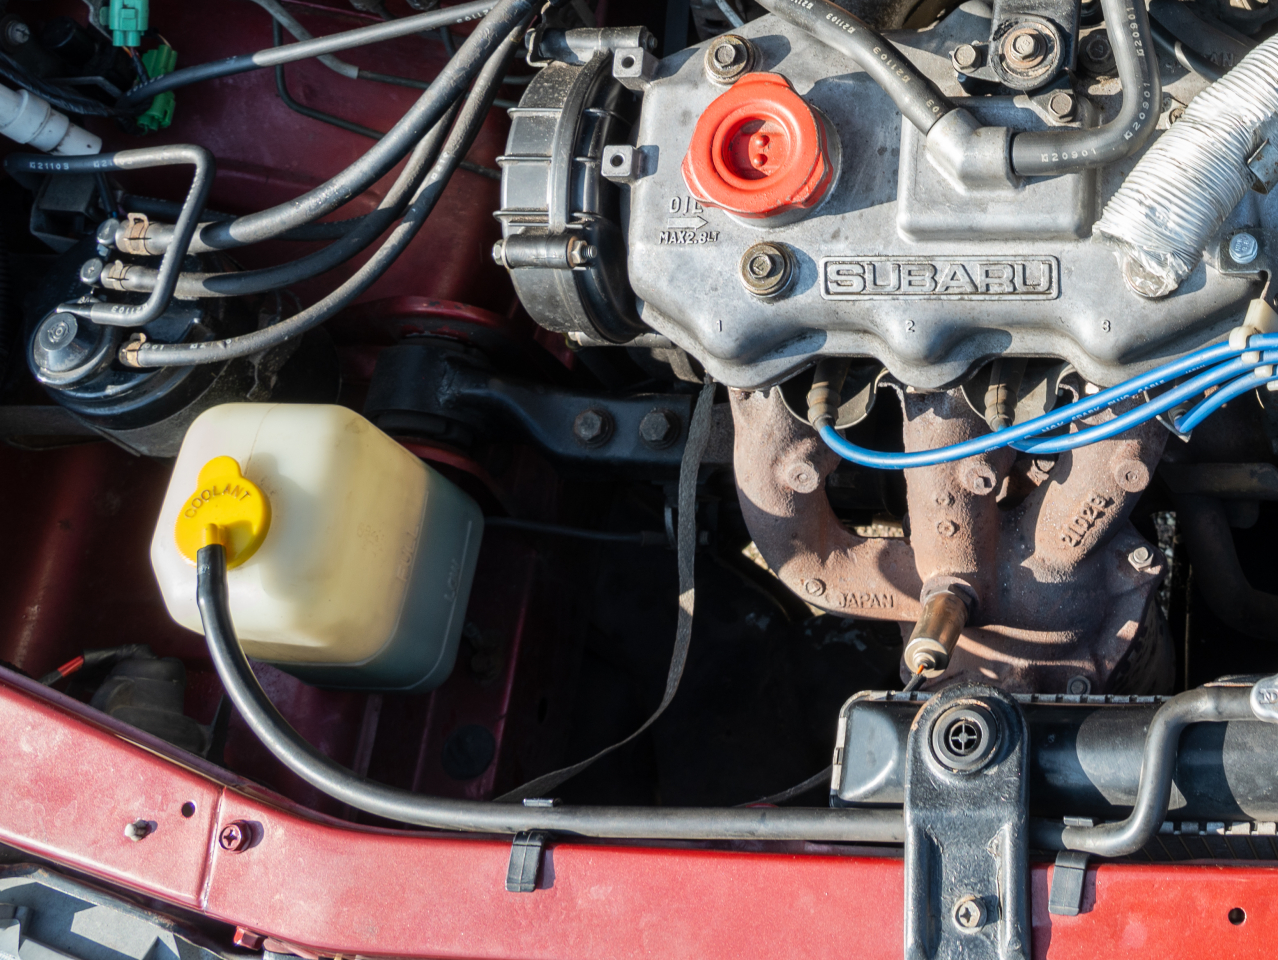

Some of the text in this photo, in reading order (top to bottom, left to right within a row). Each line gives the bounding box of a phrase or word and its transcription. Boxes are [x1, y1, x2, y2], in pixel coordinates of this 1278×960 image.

[827, 262, 1053, 294] SUBARU
[184, 483, 251, 519] COOLANT
[839, 592, 894, 608] JAPAN
